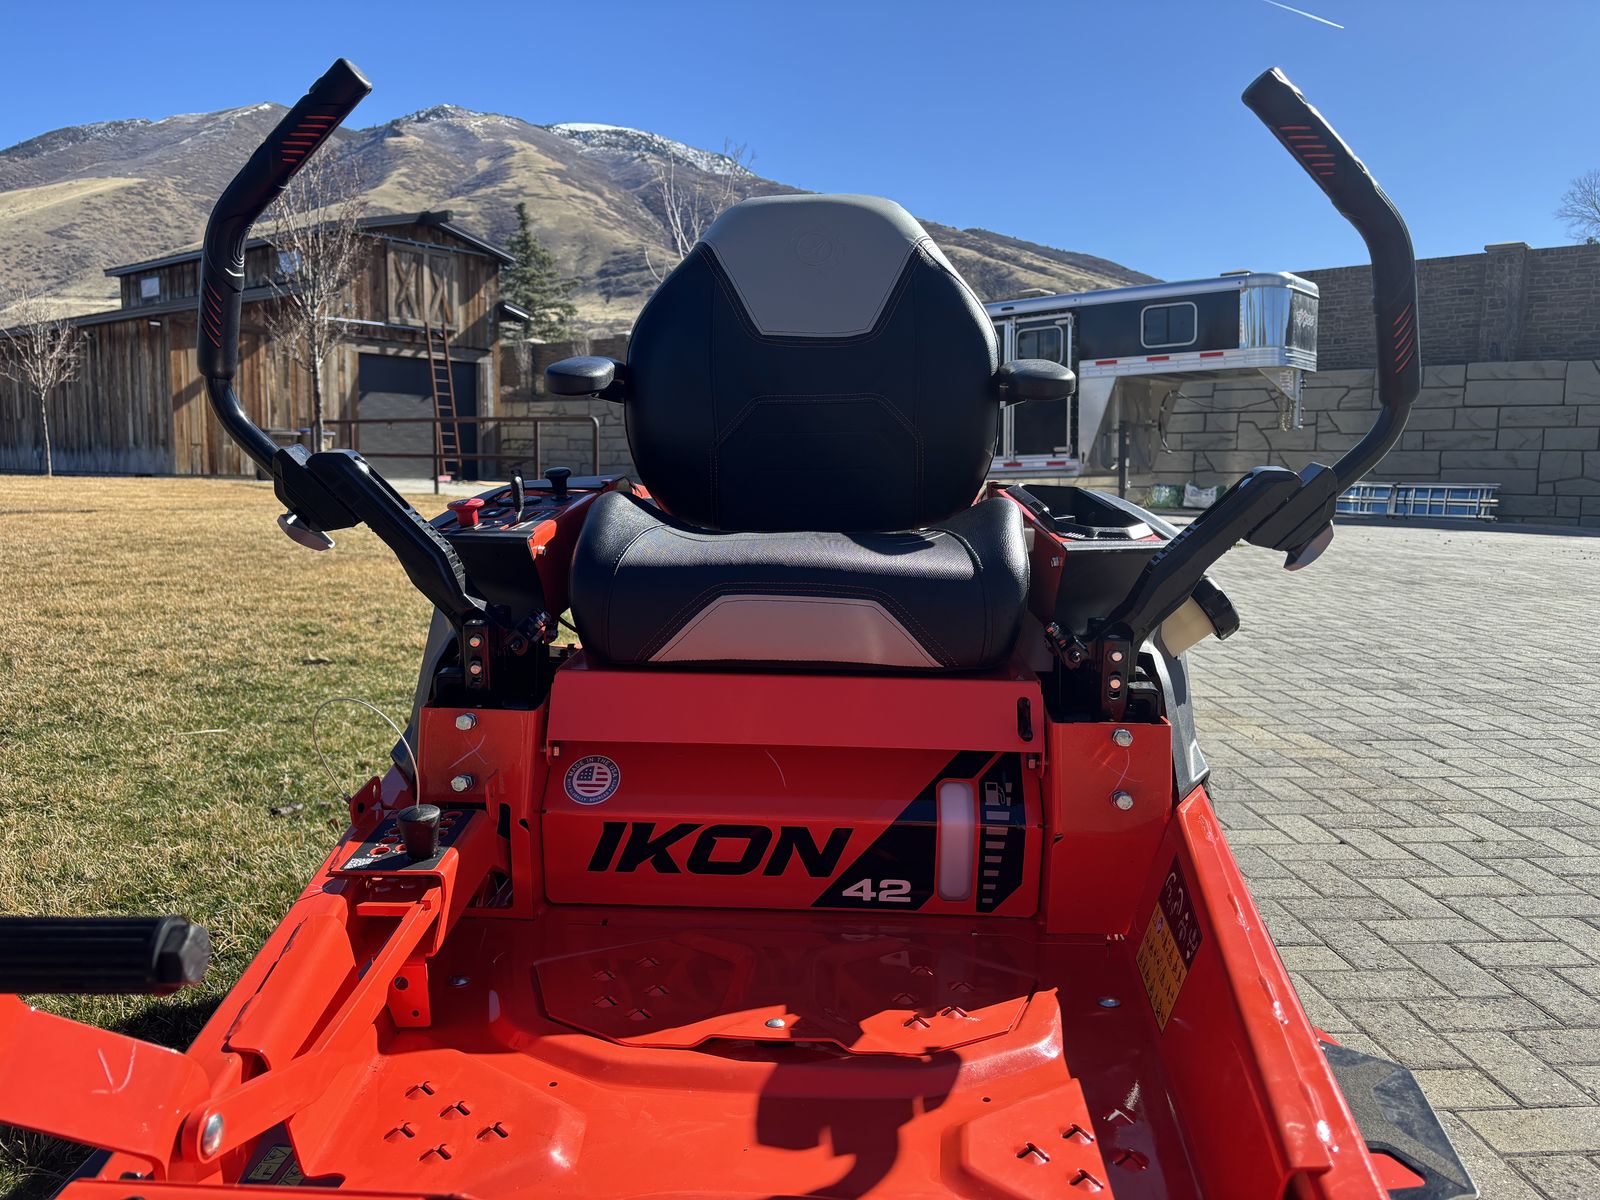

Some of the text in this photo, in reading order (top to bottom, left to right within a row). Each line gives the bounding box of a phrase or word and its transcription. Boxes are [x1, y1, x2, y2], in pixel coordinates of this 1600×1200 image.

[568, 760, 585, 776] MADE
[597, 757, 609, 765] THE
[609, 765, 618, 778] USA
[586, 821, 855, 878] IKON
[842, 878, 911, 902] 42
